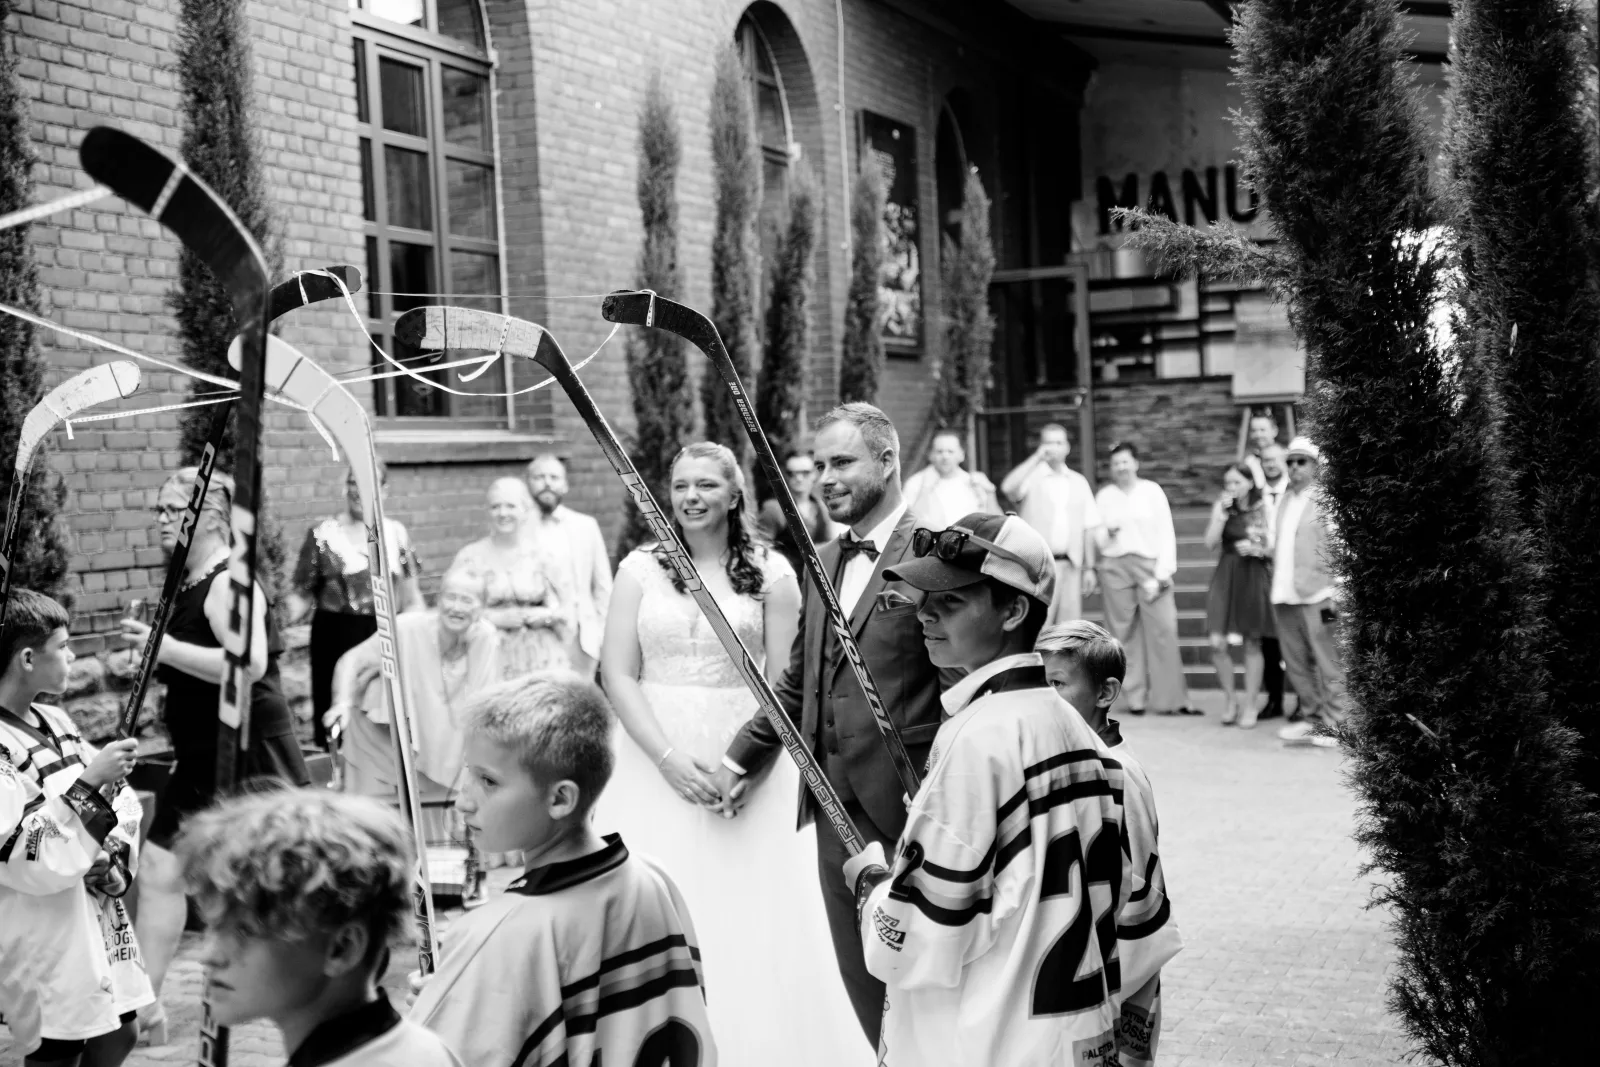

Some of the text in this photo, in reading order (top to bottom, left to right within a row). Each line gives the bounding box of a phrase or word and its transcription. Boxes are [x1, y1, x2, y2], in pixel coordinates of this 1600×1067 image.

[727, 380, 758, 433] DEFENDER ONE
[177, 441, 216, 548] CCM
[619, 472, 702, 591] CCM
[218, 504, 256, 730] CCM
[371, 575, 397, 681] BAUER
[778, 729, 856, 844] RIBCOR
